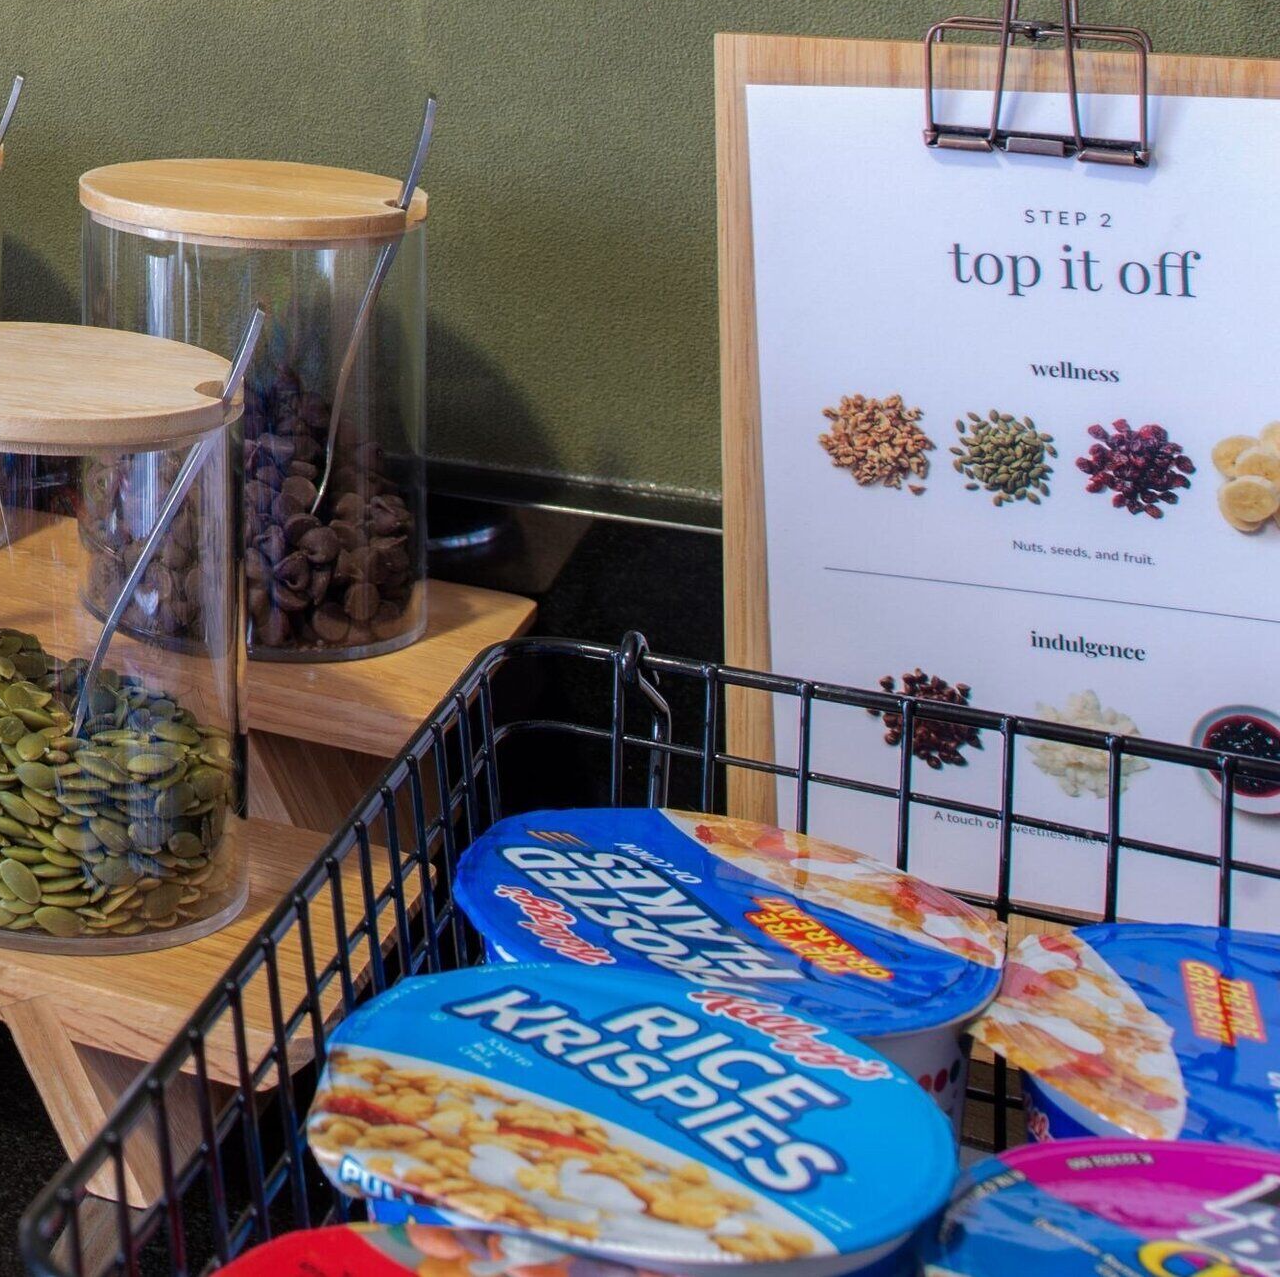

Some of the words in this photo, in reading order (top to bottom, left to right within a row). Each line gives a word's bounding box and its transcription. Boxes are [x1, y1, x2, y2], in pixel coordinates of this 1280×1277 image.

[1024, 209, 1088, 228] STEP
[1100, 212, 1113, 228] 2
[947, 241, 1041, 296] top
[1061, 244, 1103, 292] it
[1119, 250, 1202, 298] off
[1030, 360, 1120, 384] wellness
[1012, 539, 1047, 555] Nuts,
[1050, 544, 1091, 560] seeds,
[1094, 549, 1120, 562] and
[1123, 552, 1156, 567] fruit.
[1030, 630, 1147, 662] indulgence
[934, 810, 944, 821] A
[946, 812, 983, 828] touch
[1010, 825, 1071, 841] weetness
[501, 847, 762, 993] FROSTED
[566, 850, 806, 981] FLAKES
[602, 1006, 840, 1121] RICE
[687, 988, 893, 1083] Kellogg's
[453, 989, 838, 1192] KRISPIES
